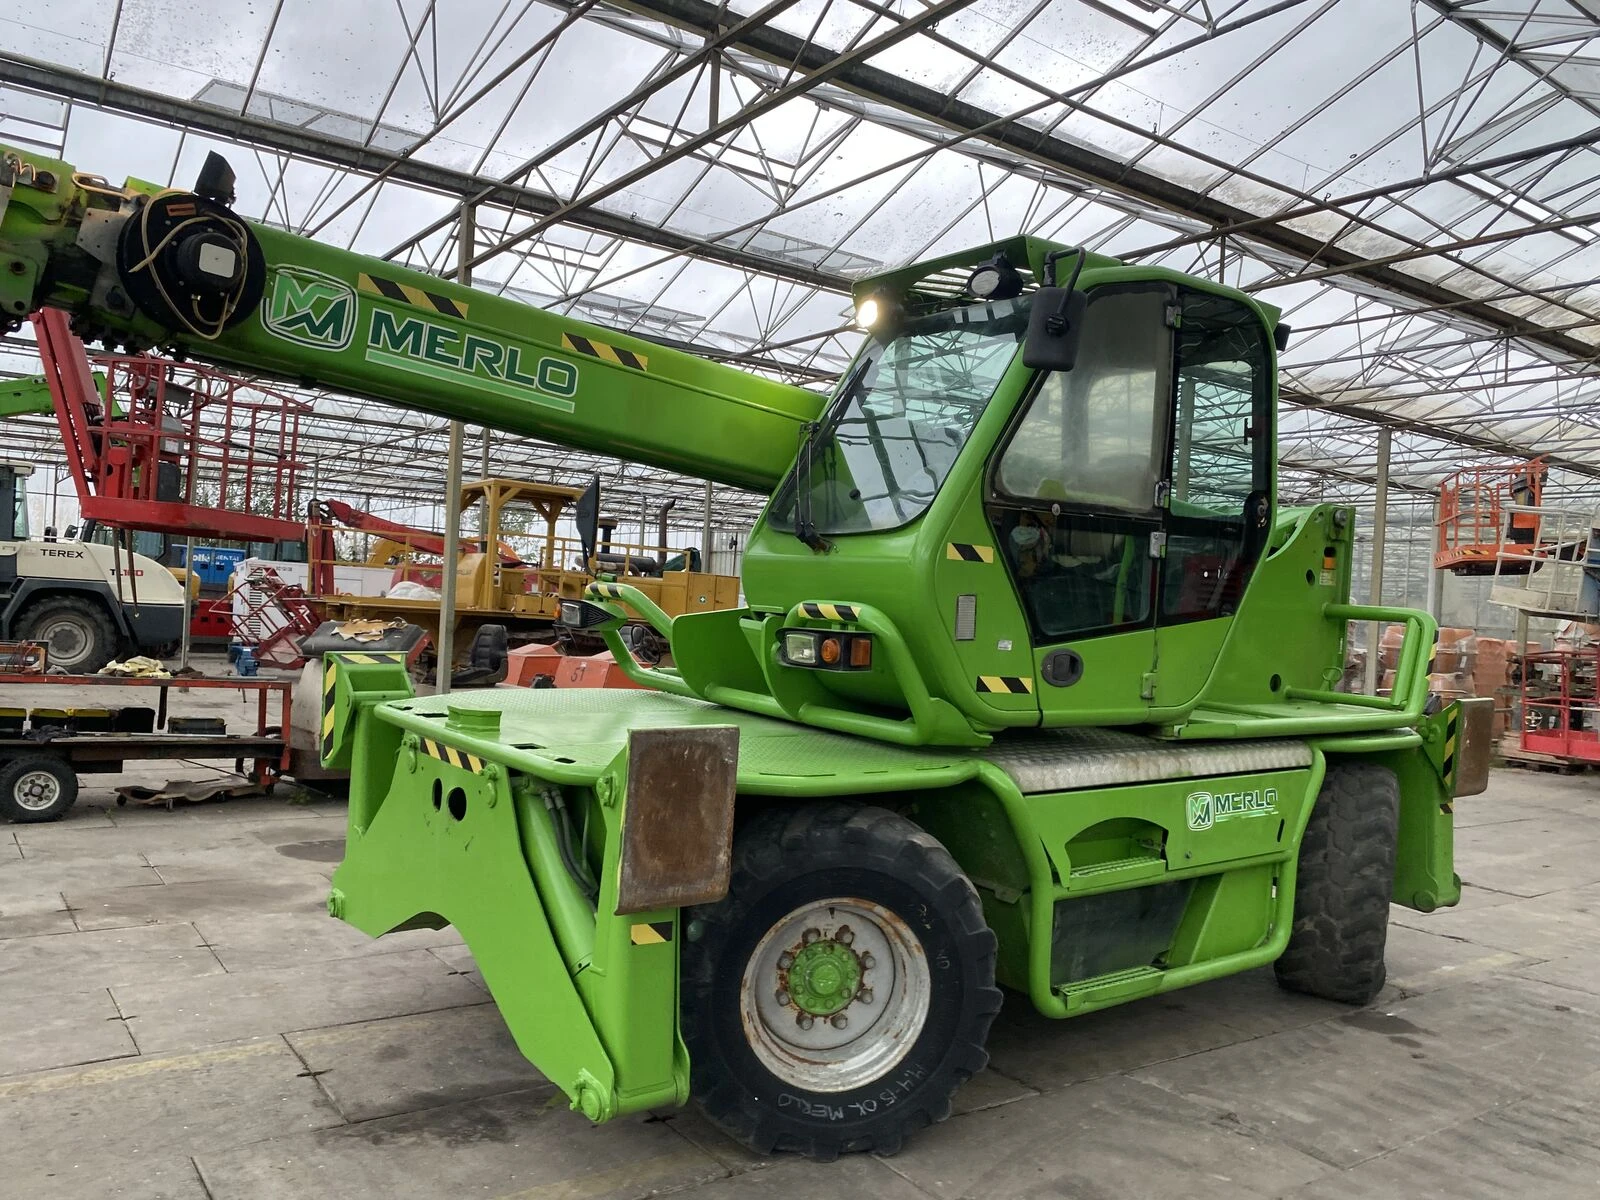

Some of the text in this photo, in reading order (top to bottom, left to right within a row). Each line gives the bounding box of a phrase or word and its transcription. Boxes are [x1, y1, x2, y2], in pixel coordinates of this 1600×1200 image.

[367, 307, 579, 397] MERLO
[40, 548, 84, 559] TEREX
[1214, 788, 1278, 814] MERLO
[778, 1092, 844, 1121] MERLO
